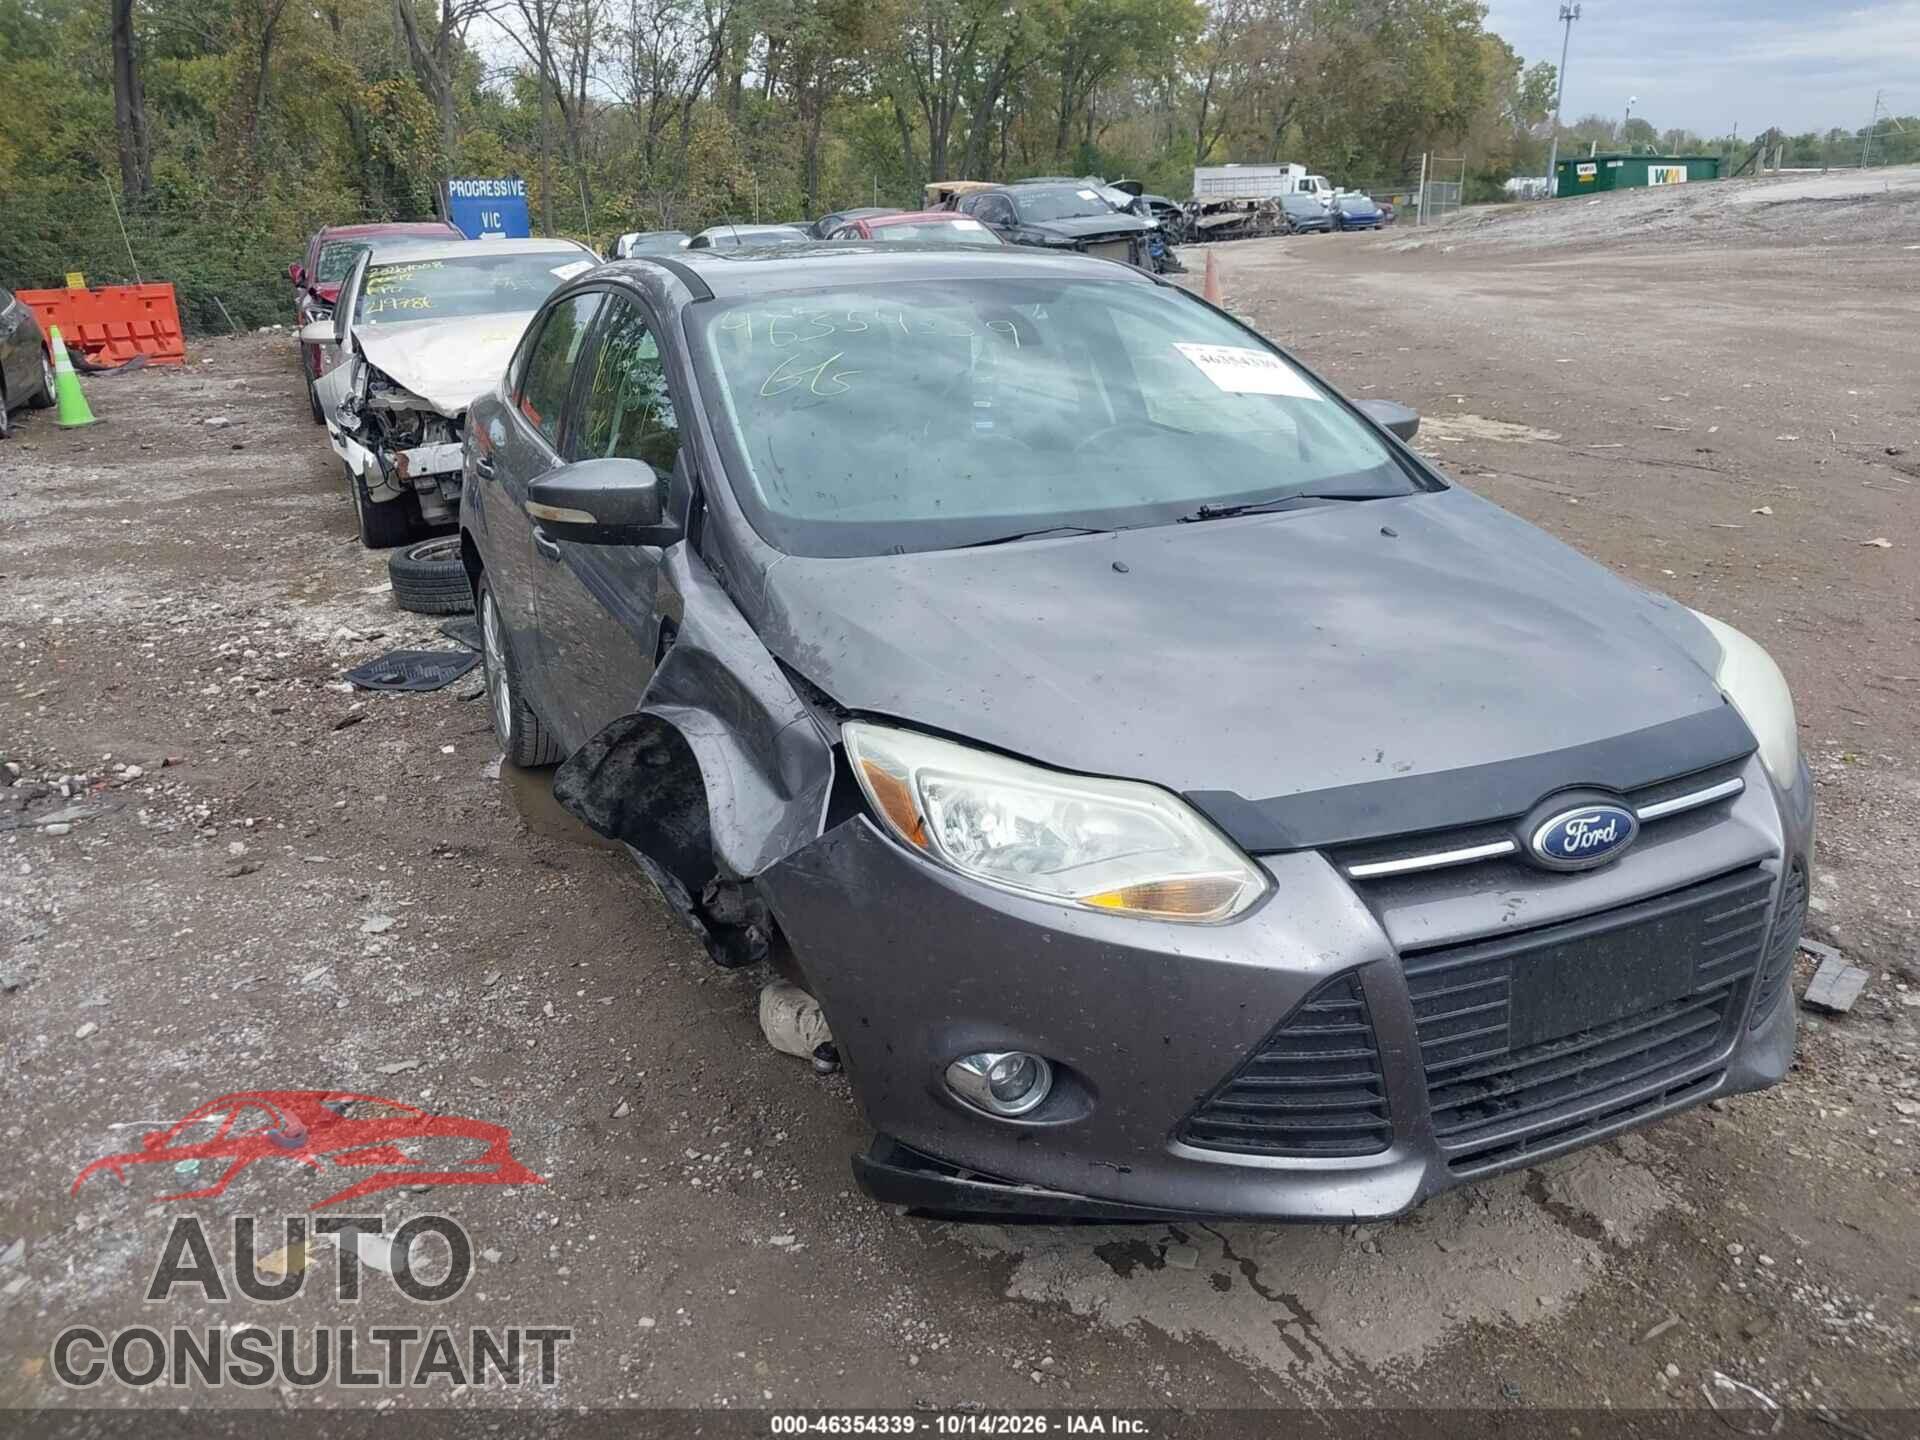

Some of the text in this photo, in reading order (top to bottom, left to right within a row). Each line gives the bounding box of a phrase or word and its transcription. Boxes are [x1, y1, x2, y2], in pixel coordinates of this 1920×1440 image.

[1655, 167, 1680, 183] WM
[449, 180, 525, 197] PROGRESSIVE
[481, 211, 502, 228] VIC
[1564, 815, 1618, 853] Ford
